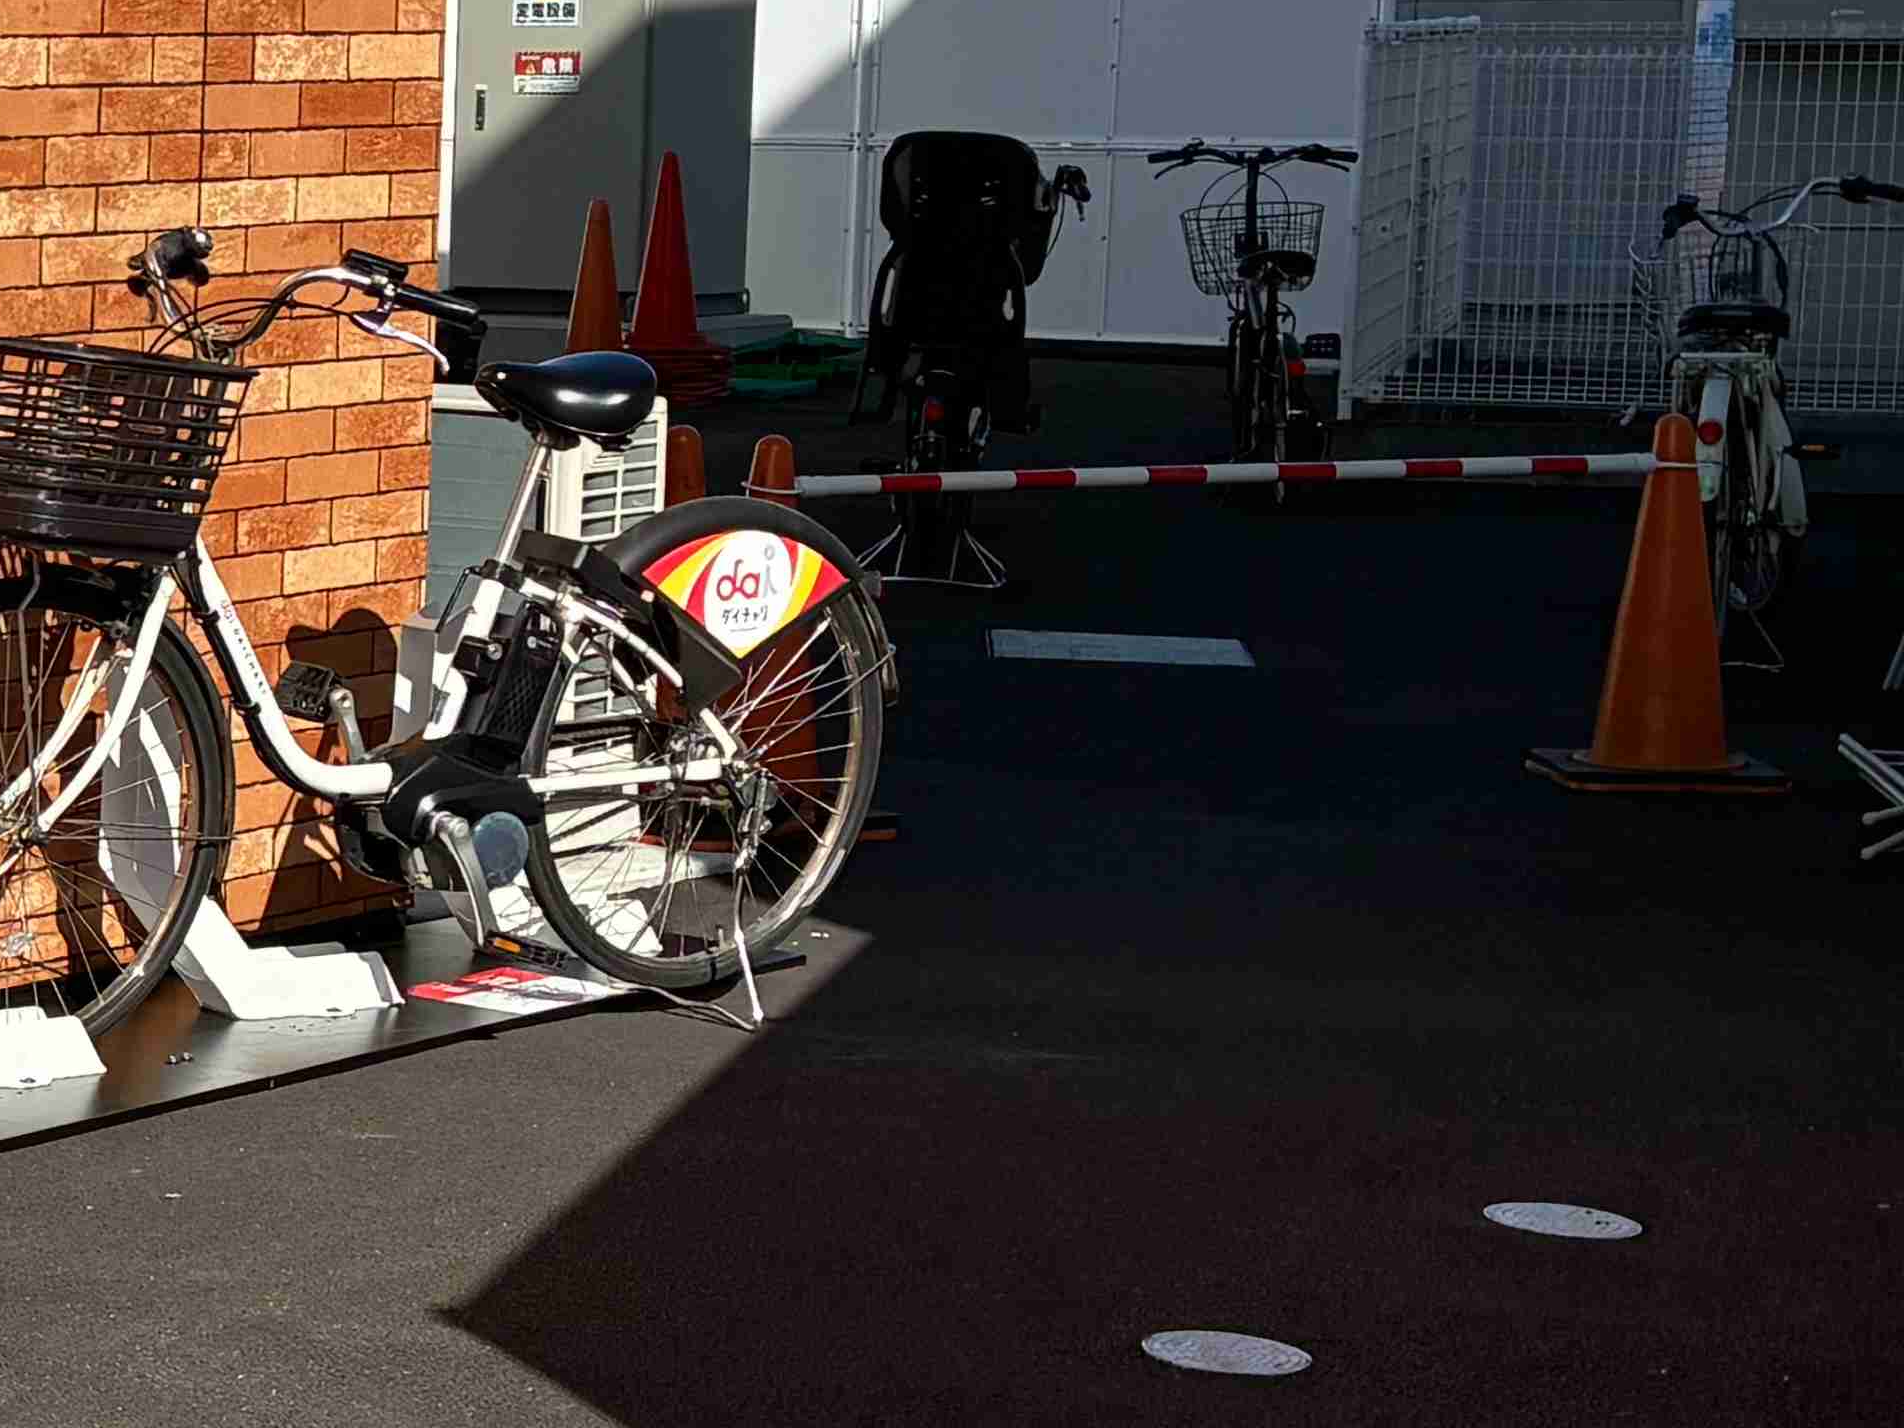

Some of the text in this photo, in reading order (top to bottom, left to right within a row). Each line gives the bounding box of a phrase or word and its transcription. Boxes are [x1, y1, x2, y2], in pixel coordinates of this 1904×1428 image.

[721, 604, 769, 627] ダイチャリ
